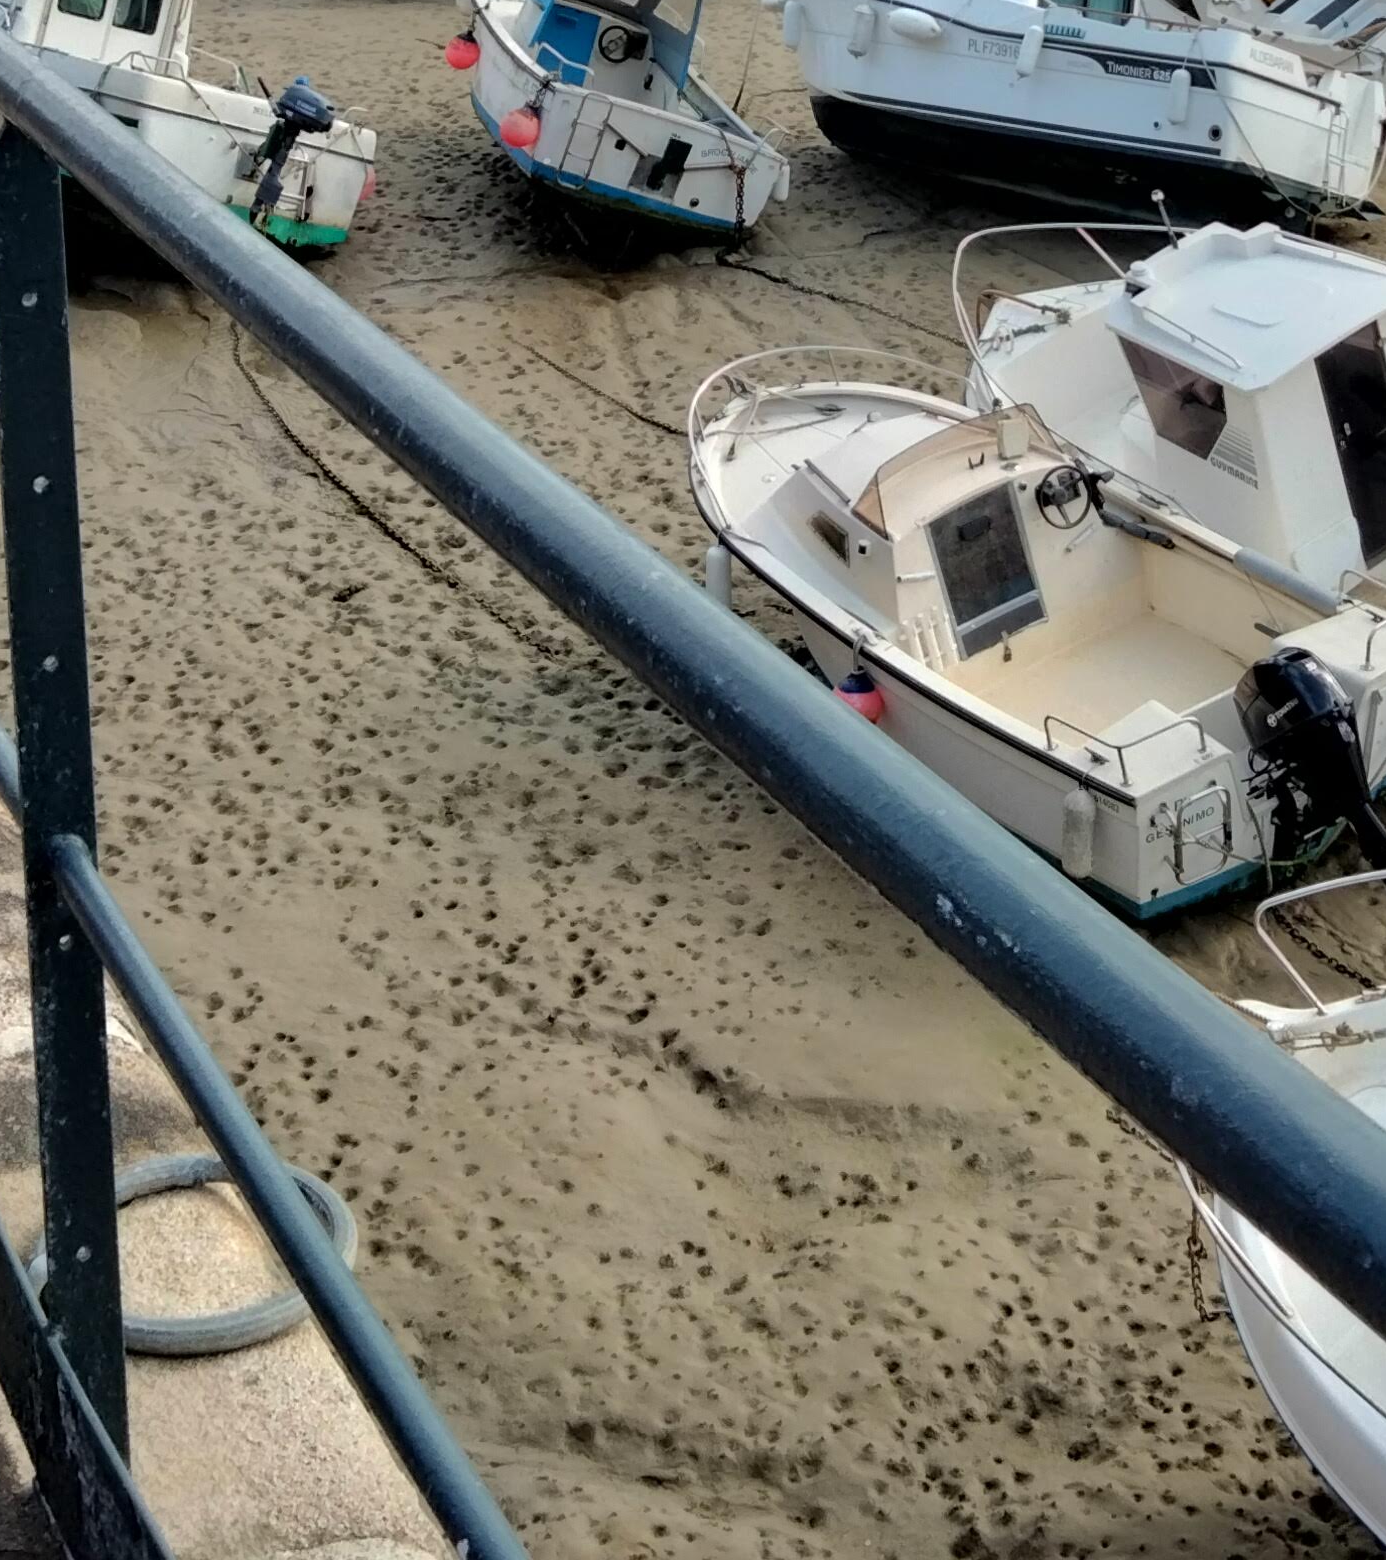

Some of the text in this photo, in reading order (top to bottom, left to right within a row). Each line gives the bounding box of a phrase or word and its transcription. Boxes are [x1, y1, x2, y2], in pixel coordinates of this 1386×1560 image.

[1106, 60, 1151, 79] TIMONIER
[1153, 69, 1172, 82] 625
[1145, 806, 1215, 844] GENIMO
